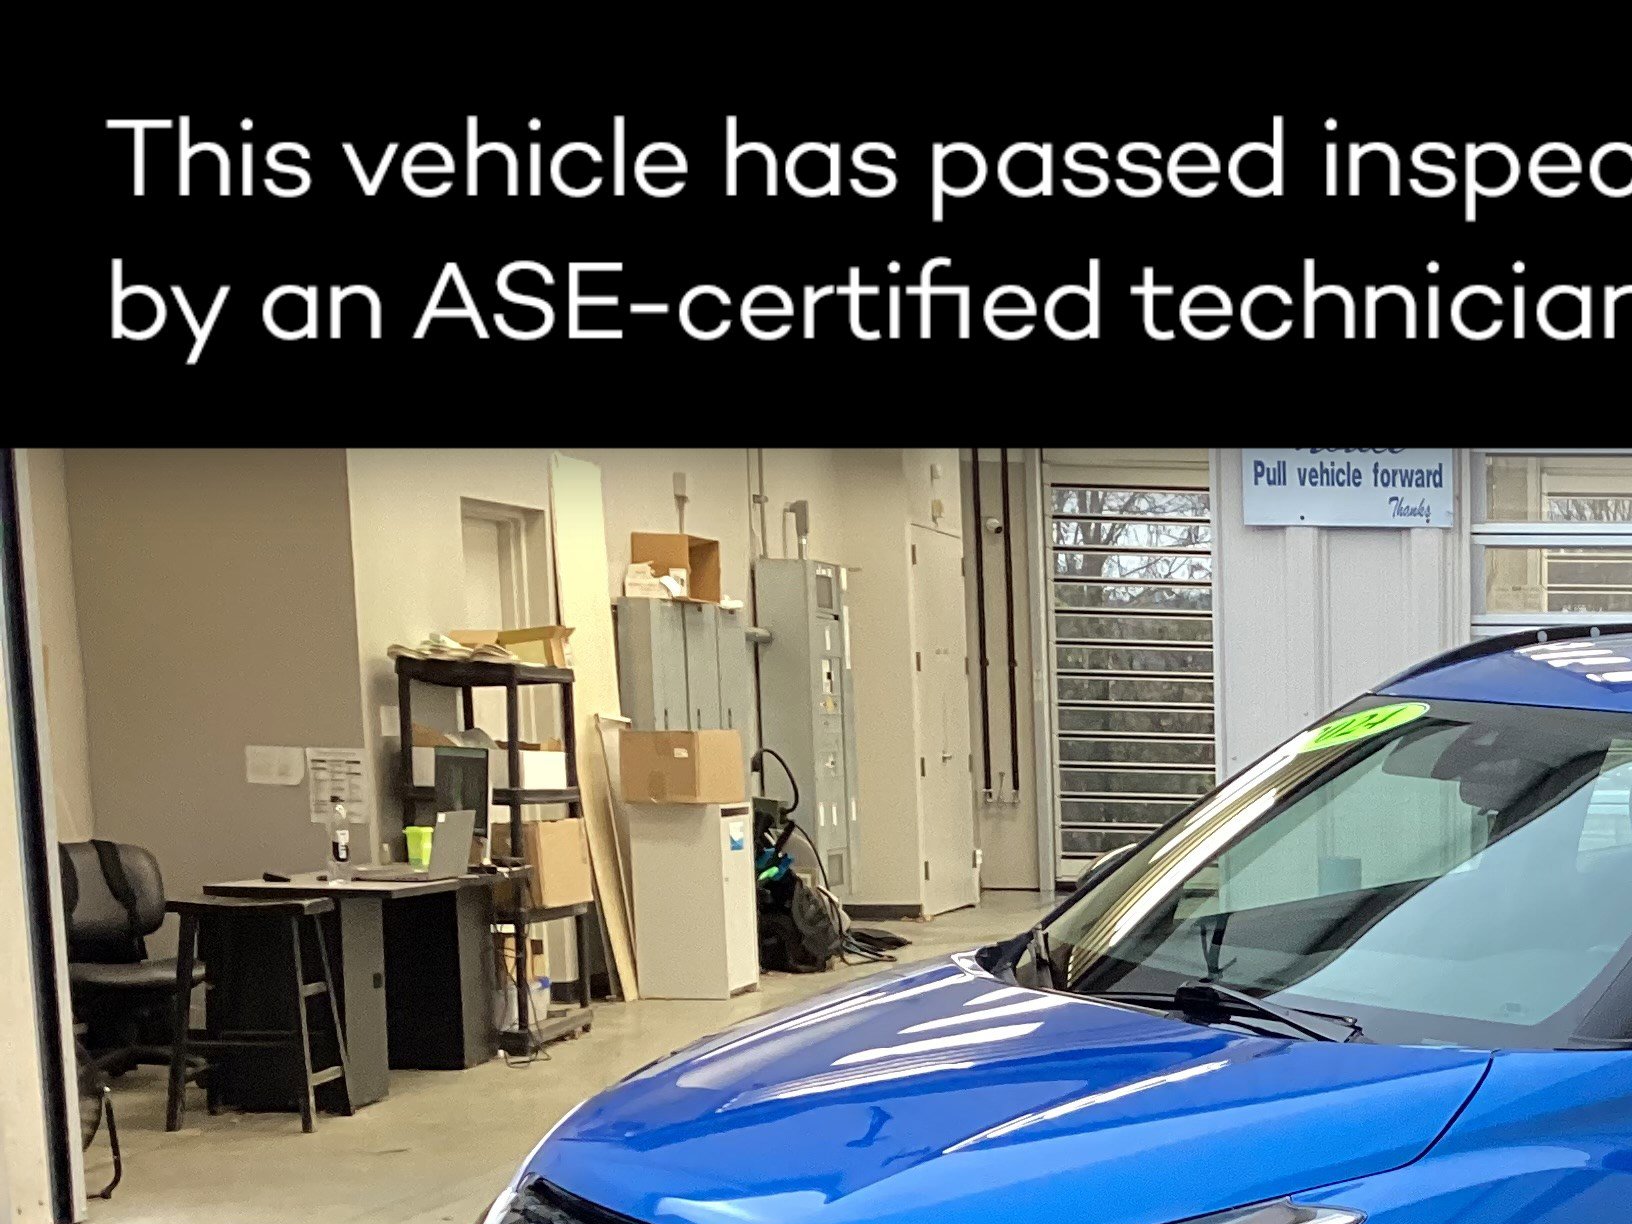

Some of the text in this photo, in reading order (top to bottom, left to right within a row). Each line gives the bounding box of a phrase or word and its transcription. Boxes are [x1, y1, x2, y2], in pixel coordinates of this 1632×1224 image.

[1253, 460, 1444, 489] Pull vehicle forward
[1388, 496, 1432, 518] Thanks
